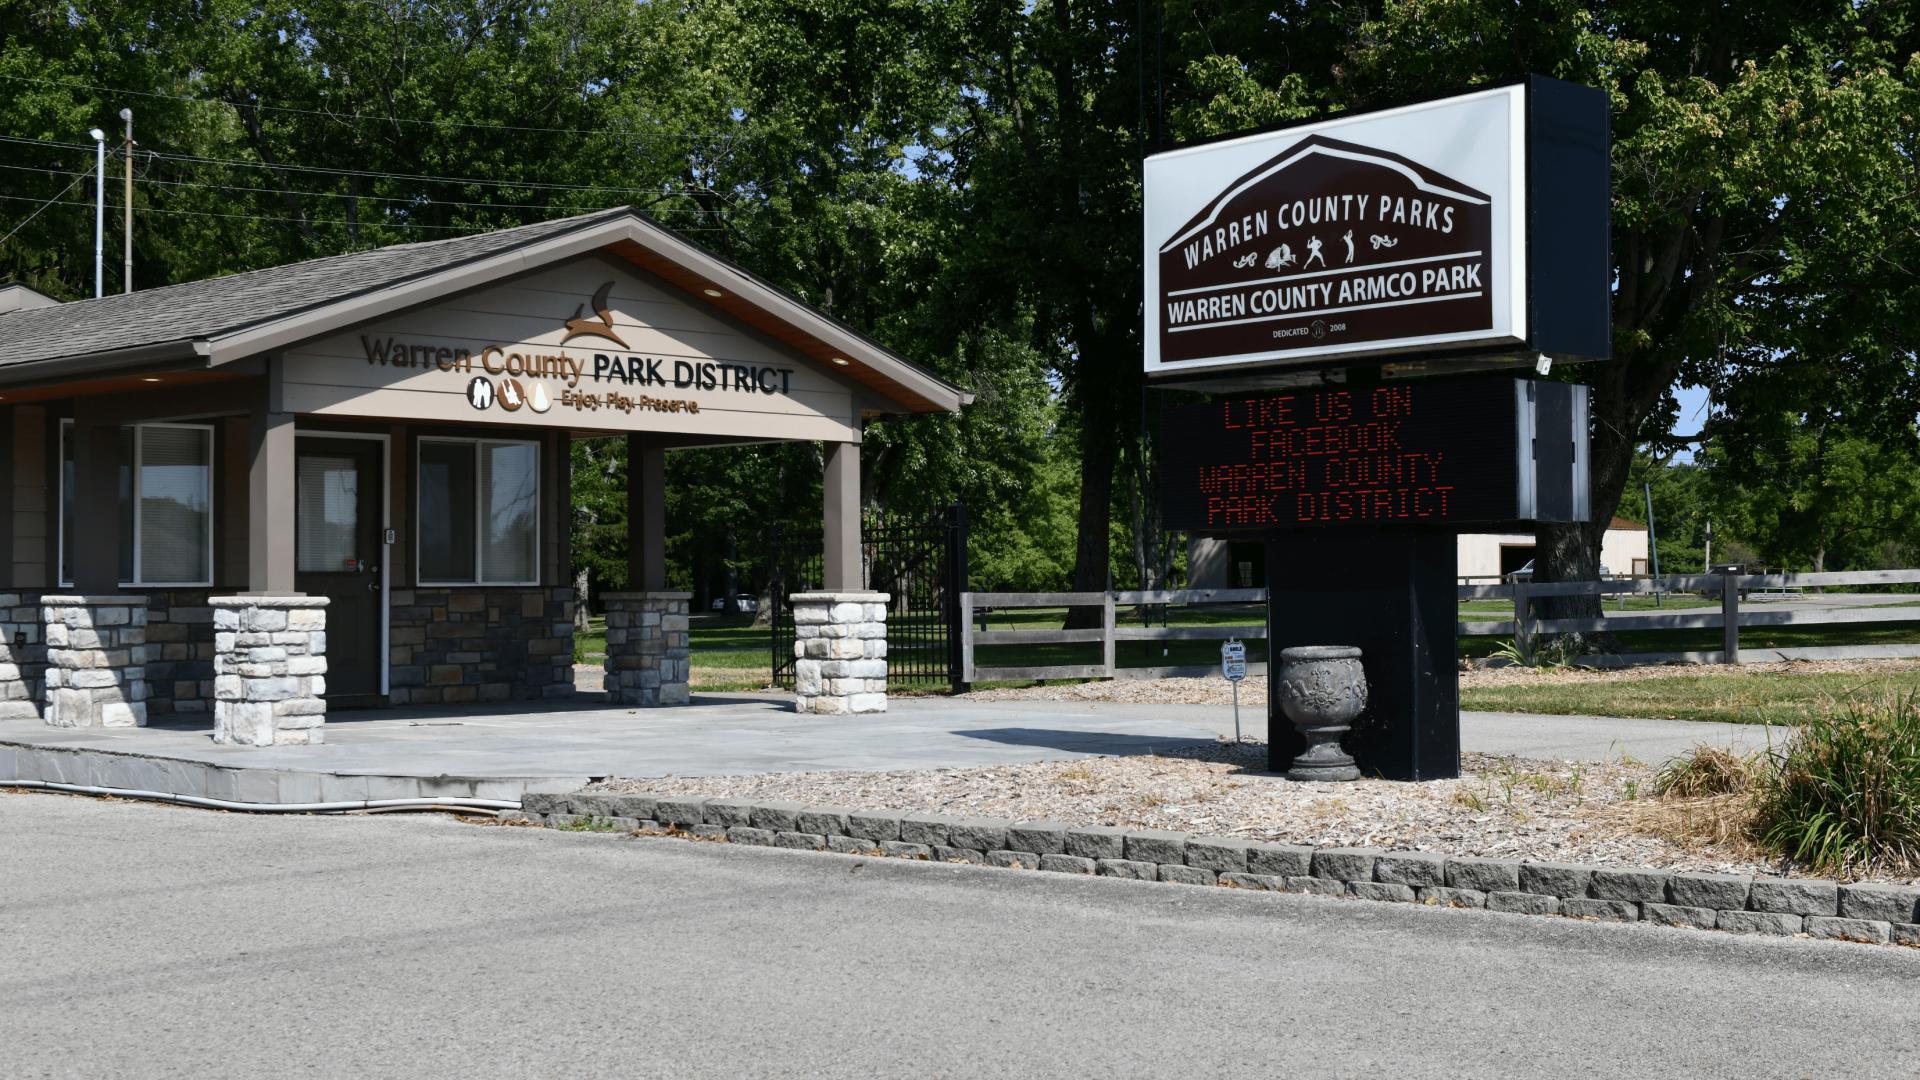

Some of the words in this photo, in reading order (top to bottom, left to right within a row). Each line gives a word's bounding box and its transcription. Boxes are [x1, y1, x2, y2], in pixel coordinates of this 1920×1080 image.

[1184, 209, 1268, 270] WARREN
[1278, 194, 1369, 230] COUNTY
[1379, 195, 1455, 234] PARKS
[1168, 293, 1246, 324] WARREN
[1250, 282, 1333, 314] COUNTY
[1338, 271, 1417, 303] ARMCO
[1422, 263, 1482, 294] PARK
[1272, 326, 1310, 338] DEDICATED
[1329, 322, 1347, 333] 2008
[361, 334, 472, 374] Warren
[482, 344, 585, 388] County
[594, 353, 666, 387] PARK
[674, 360, 795, 396] DISTRICT
[1223, 395, 1295, 429] LIKE
[1314, 391, 1352, 421] US
[1371, 385, 1412, 417] ON
[1250, 420, 1401, 459] FACEBOOK
[1198, 460, 1305, 493] WARREN
[1324, 451, 1443, 487] COUNTY
[1207, 494, 1279, 525] PARK
[1296, 486, 1454, 521] DISTRICT
